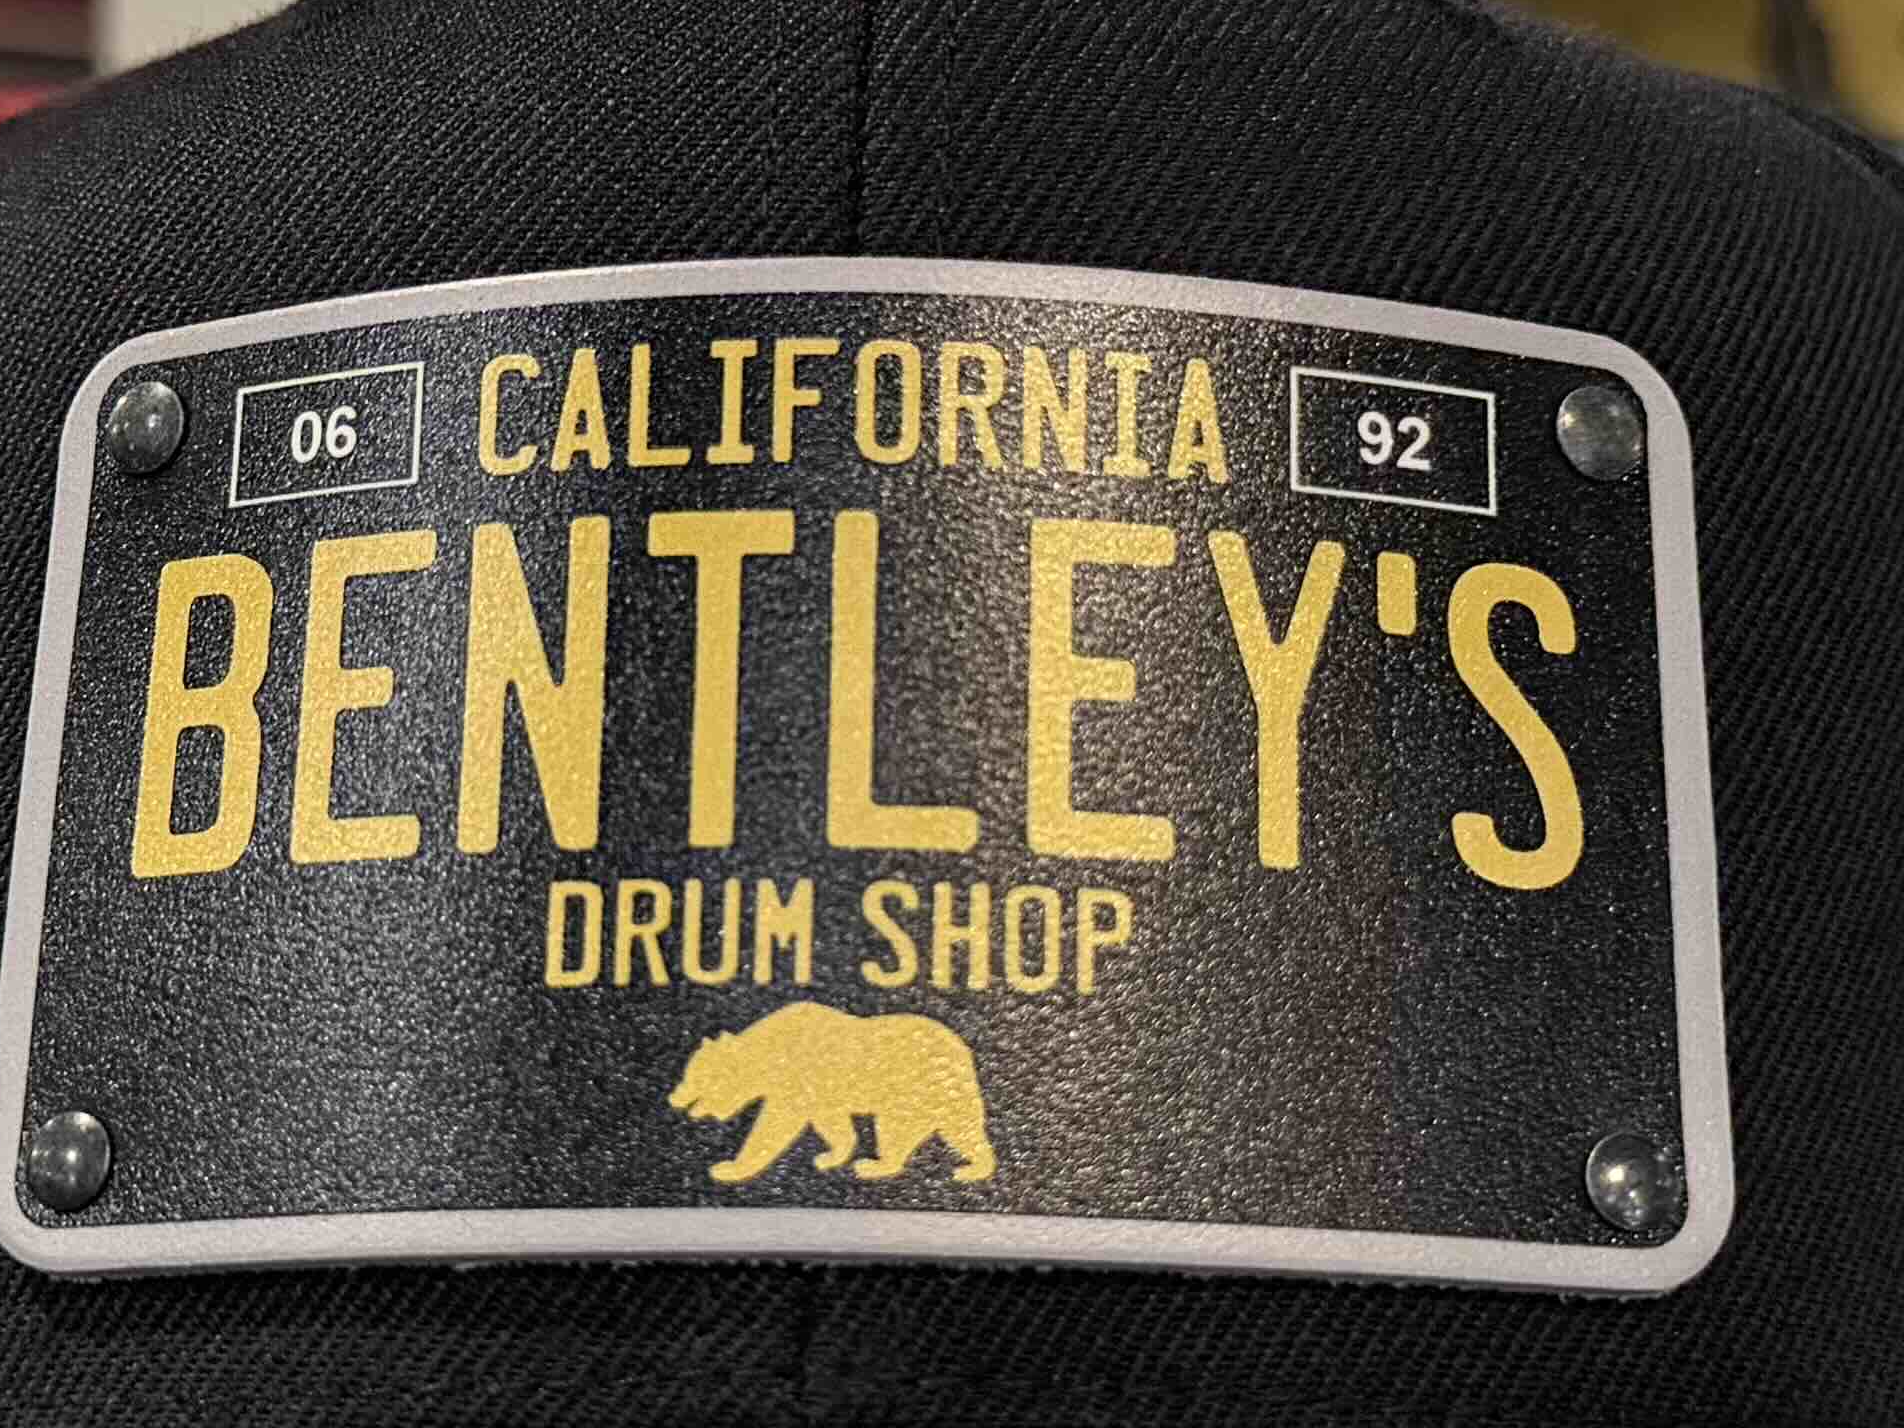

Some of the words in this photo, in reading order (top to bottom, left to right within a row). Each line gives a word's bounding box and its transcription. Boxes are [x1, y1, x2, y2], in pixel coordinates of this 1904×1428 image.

[289, 403, 358, 465] 06
[477, 336, 1230, 486] CALIFORNIA
[1356, 410, 1433, 472] 92
[131, 507, 1586, 892] BENTLEY'S
[543, 876, 815, 990] DRUM
[862, 878, 1138, 998] SHOP
